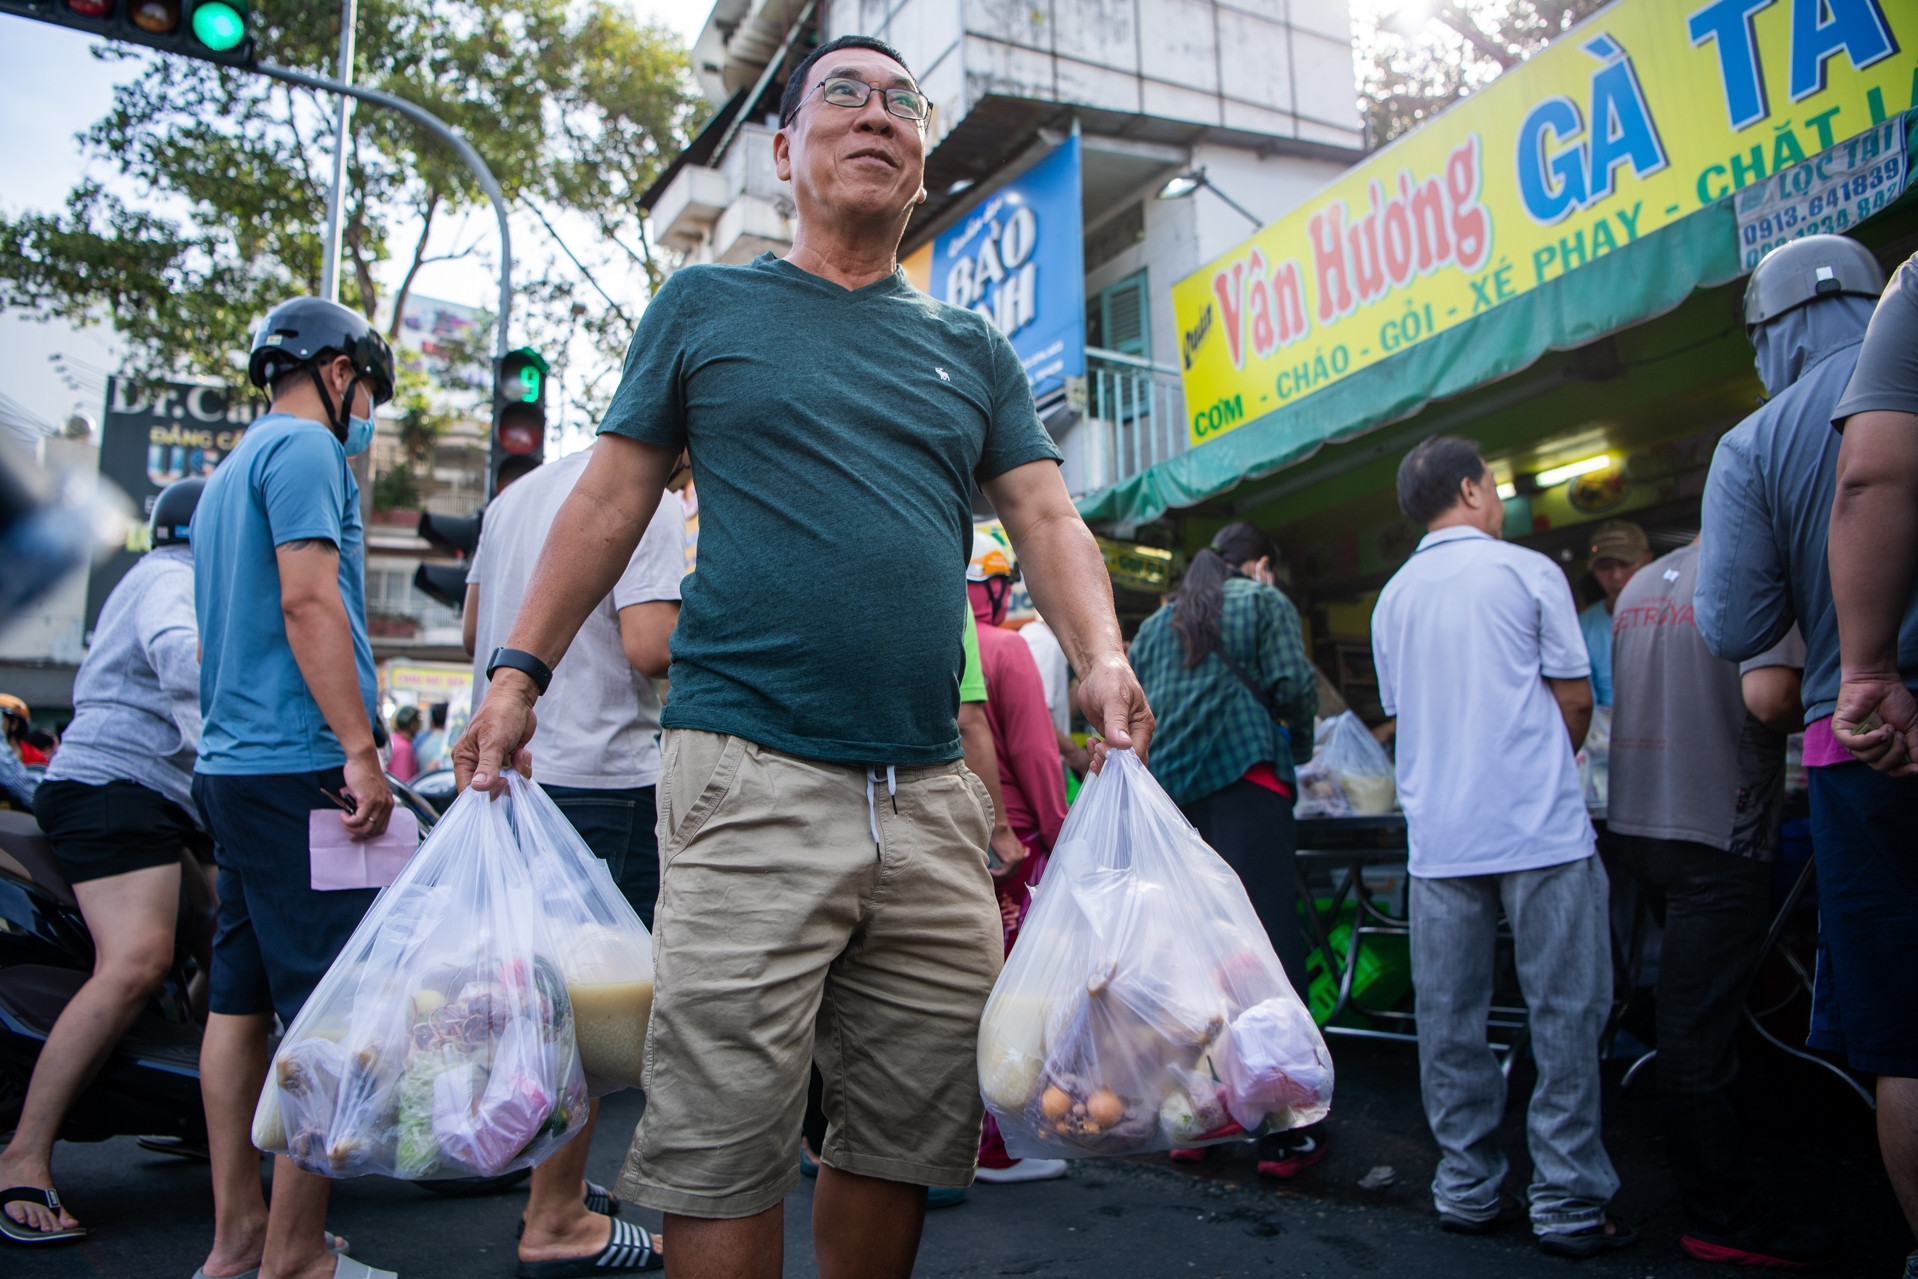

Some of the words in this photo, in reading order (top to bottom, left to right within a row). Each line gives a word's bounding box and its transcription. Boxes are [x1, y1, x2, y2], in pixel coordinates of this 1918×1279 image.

[1515, 31, 1671, 227] GÀ
[1743, 156, 1900, 247] 0913.641839
[1195, 394, 1243, 438] CƠM
[1276, 346, 1349, 400] CHÁO
[1380, 299, 1434, 353] GỎI
[1469, 256, 1517, 315] XÉ
[1533, 200, 1643, 284] PHAY
[1212, 245, 1311, 371] Vân
[1307, 131, 1493, 326] Hương
[520, 366, 541, 403] 9
